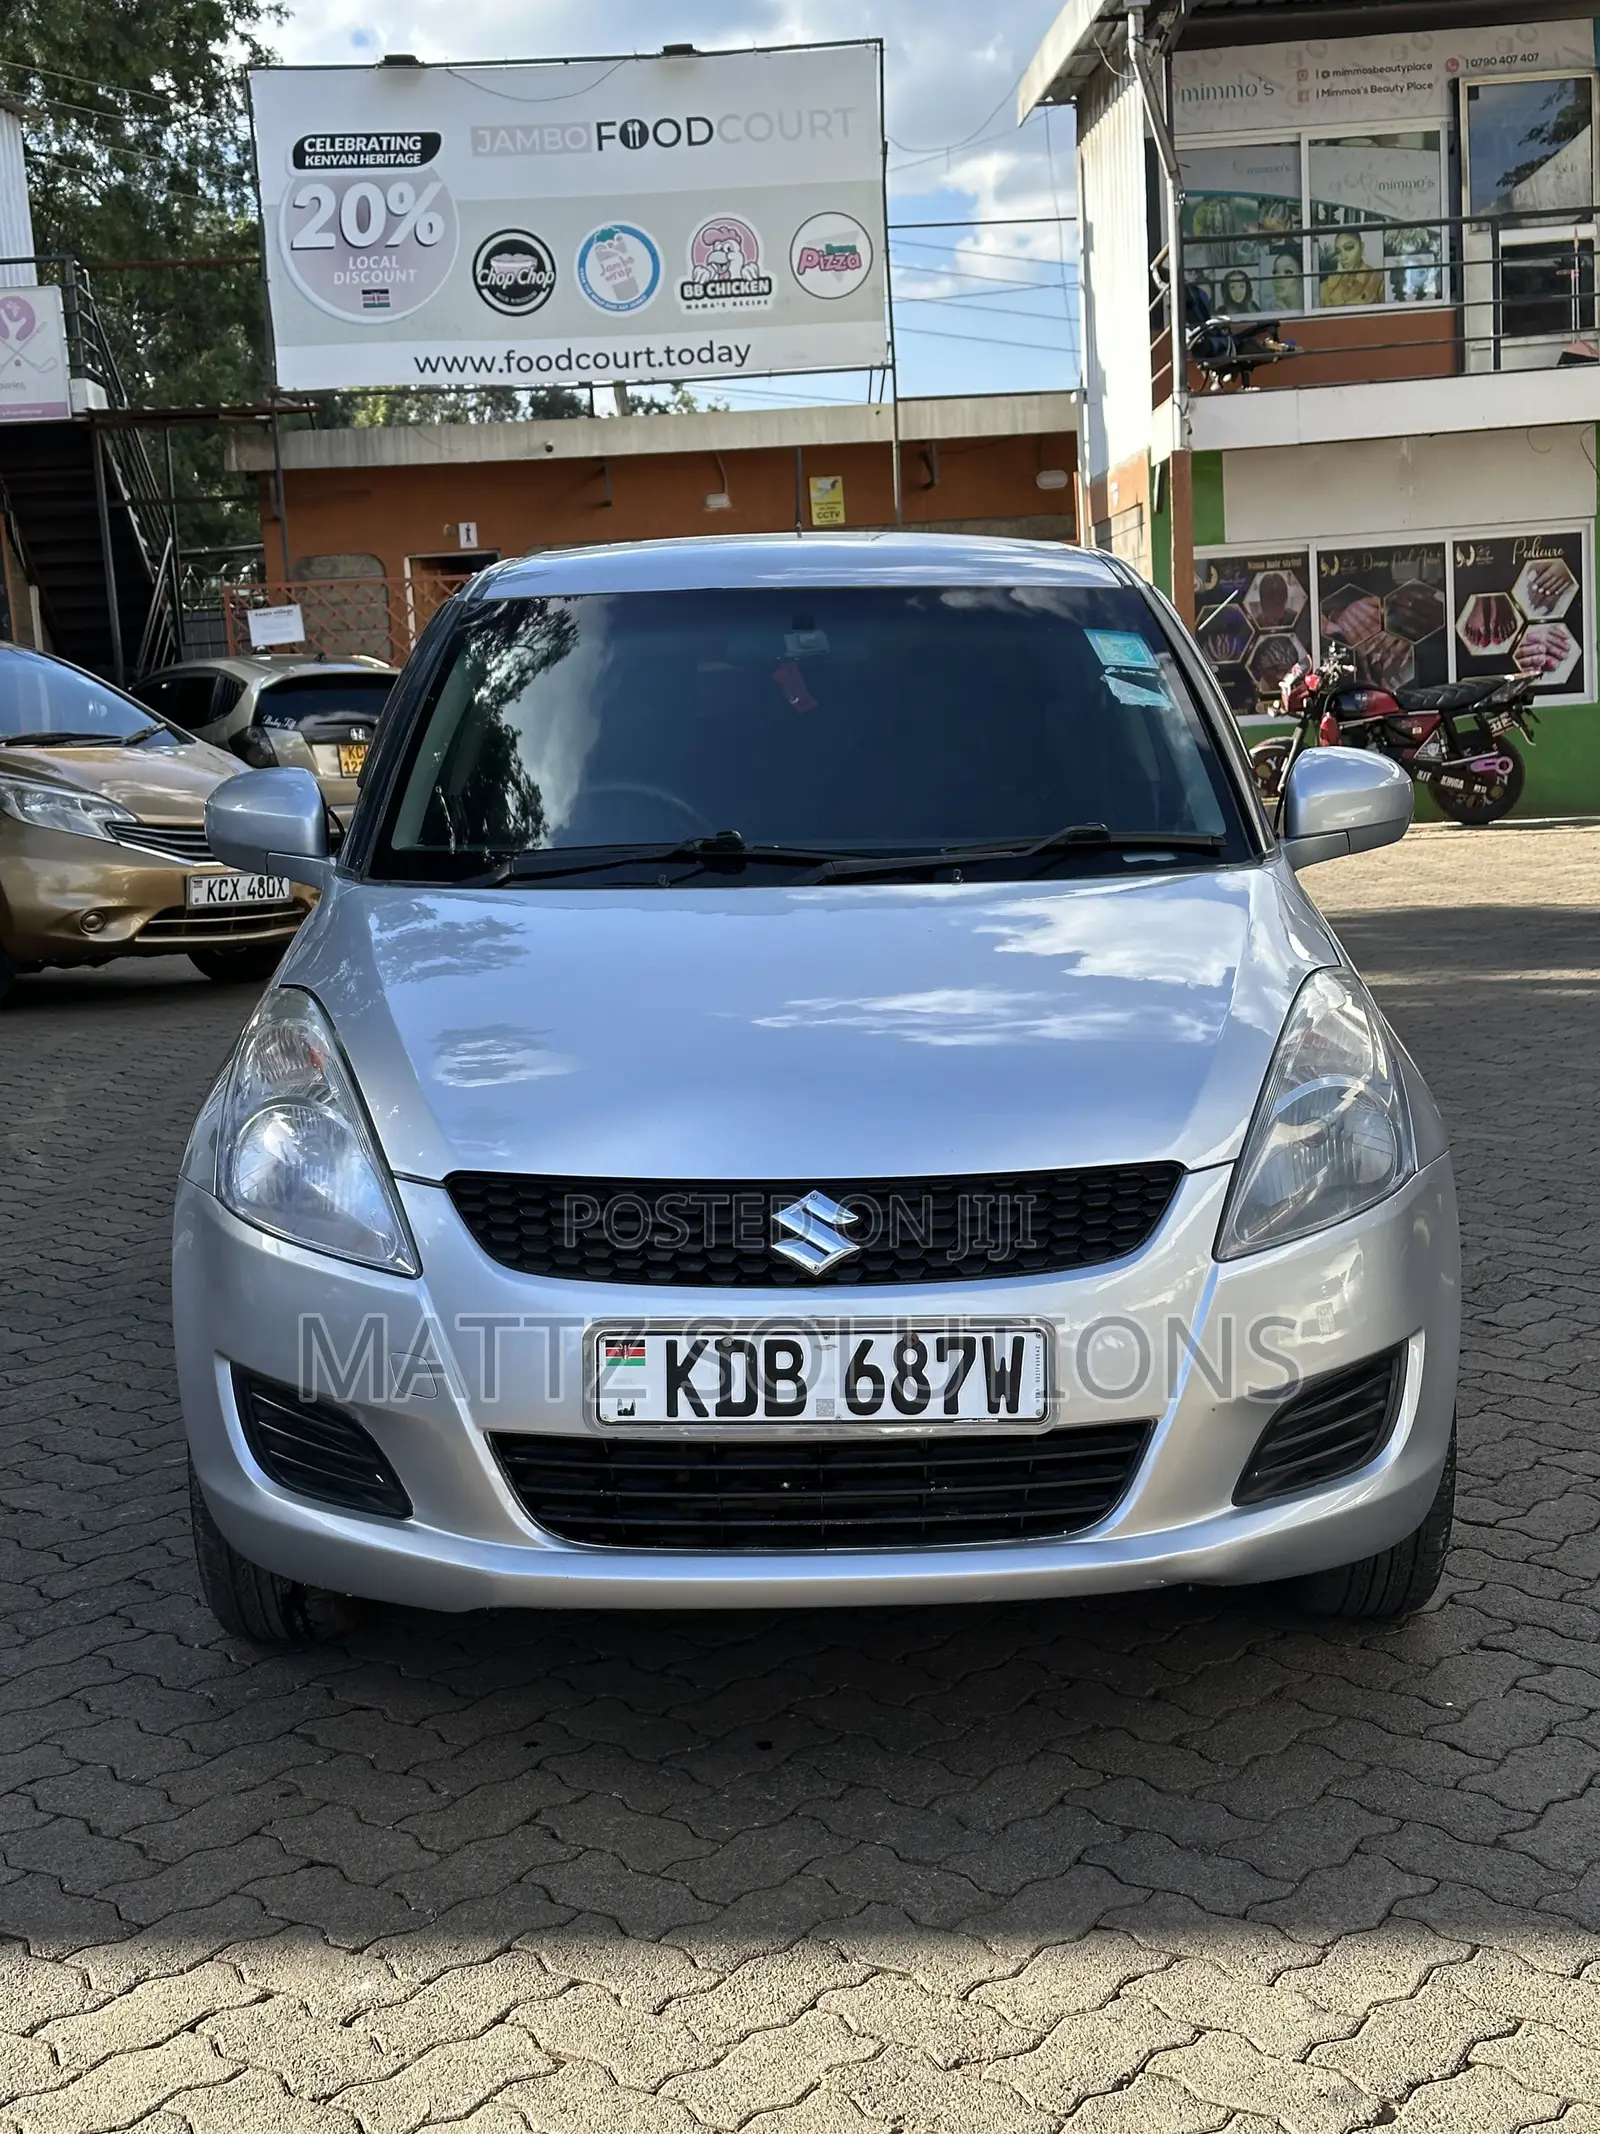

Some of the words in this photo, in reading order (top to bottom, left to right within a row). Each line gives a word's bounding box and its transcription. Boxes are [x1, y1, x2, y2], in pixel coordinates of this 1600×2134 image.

[1499, 54, 1518, 65] 407
[1520, 53, 1539, 63] 407
[1332, 62, 1433, 78] mimmosbeautyplace
[1181, 76, 1275, 102] mimmo's
[1370, 84, 1404, 94] Beauty
[1407, 82, 1433, 90] Place
[303, 136, 422, 152] CELEBRATING
[476, 126, 588, 154] JAMBO
[305, 154, 358, 166] KENYAN
[359, 153, 422, 165] HERITAGE
[291, 180, 446, 251] 20%
[349, 255, 400, 270] LOCAL
[797, 246, 862, 275] Pizza
[334, 269, 419, 285] DISCOUNT
[477, 268, 515, 289] Chop
[517, 266, 555, 288] Chop
[683, 284, 704, 298] BB
[706, 280, 770, 297] CHICKEN
[414, 340, 752, 376] www.foodcourt.today
[816, 510, 841, 520] CCTV
[1512, 536, 1565, 565] Pedicure
[207, 878, 240, 902] KCX
[247, 876, 285, 899] 480X
[665, 1338, 808, 1418] KDB
[844, 1334, 1026, 1416] 687W
